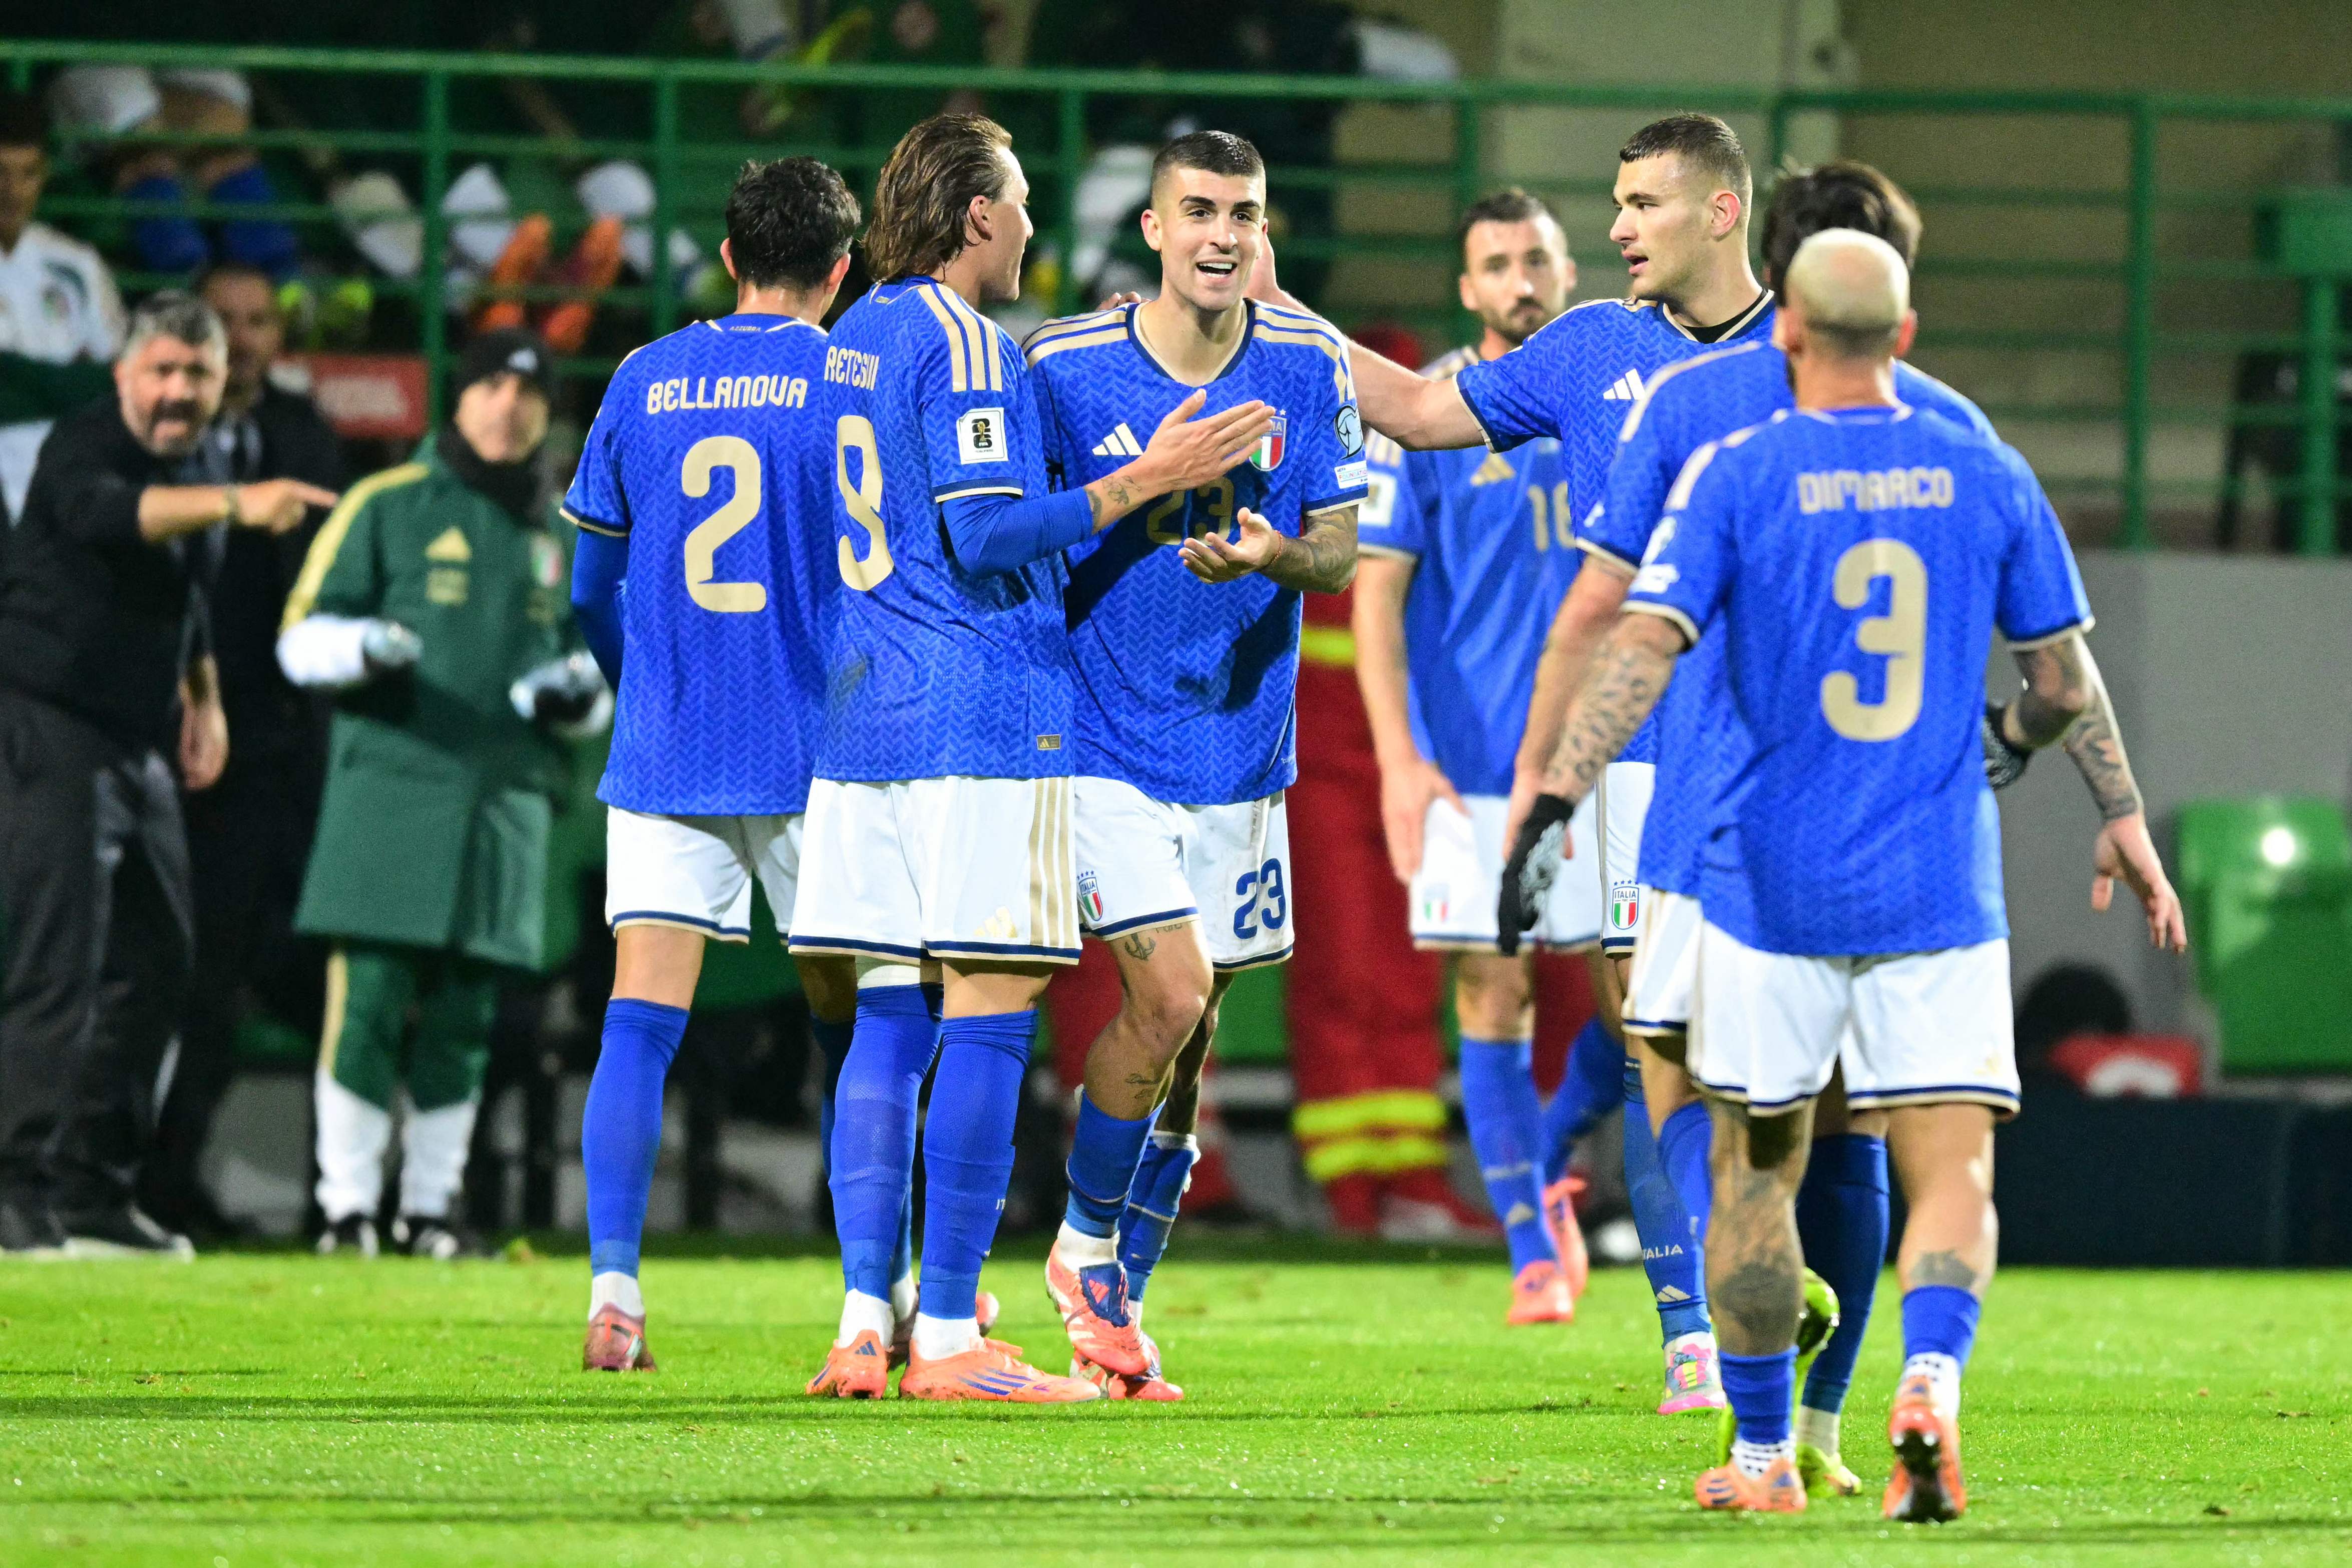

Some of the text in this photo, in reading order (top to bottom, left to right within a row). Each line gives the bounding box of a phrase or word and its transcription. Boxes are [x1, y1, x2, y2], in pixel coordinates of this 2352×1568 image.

[647, 375, 808, 415] BELLANOVA
[681, 436, 766, 613] 2
[837, 415, 894, 591] 9
[1797, 466, 1953, 515] DIMARCO
[1820, 538, 1928, 742] 3
[1234, 858, 1286, 939] 23
[1615, 891, 1636, 899] ITALIA
